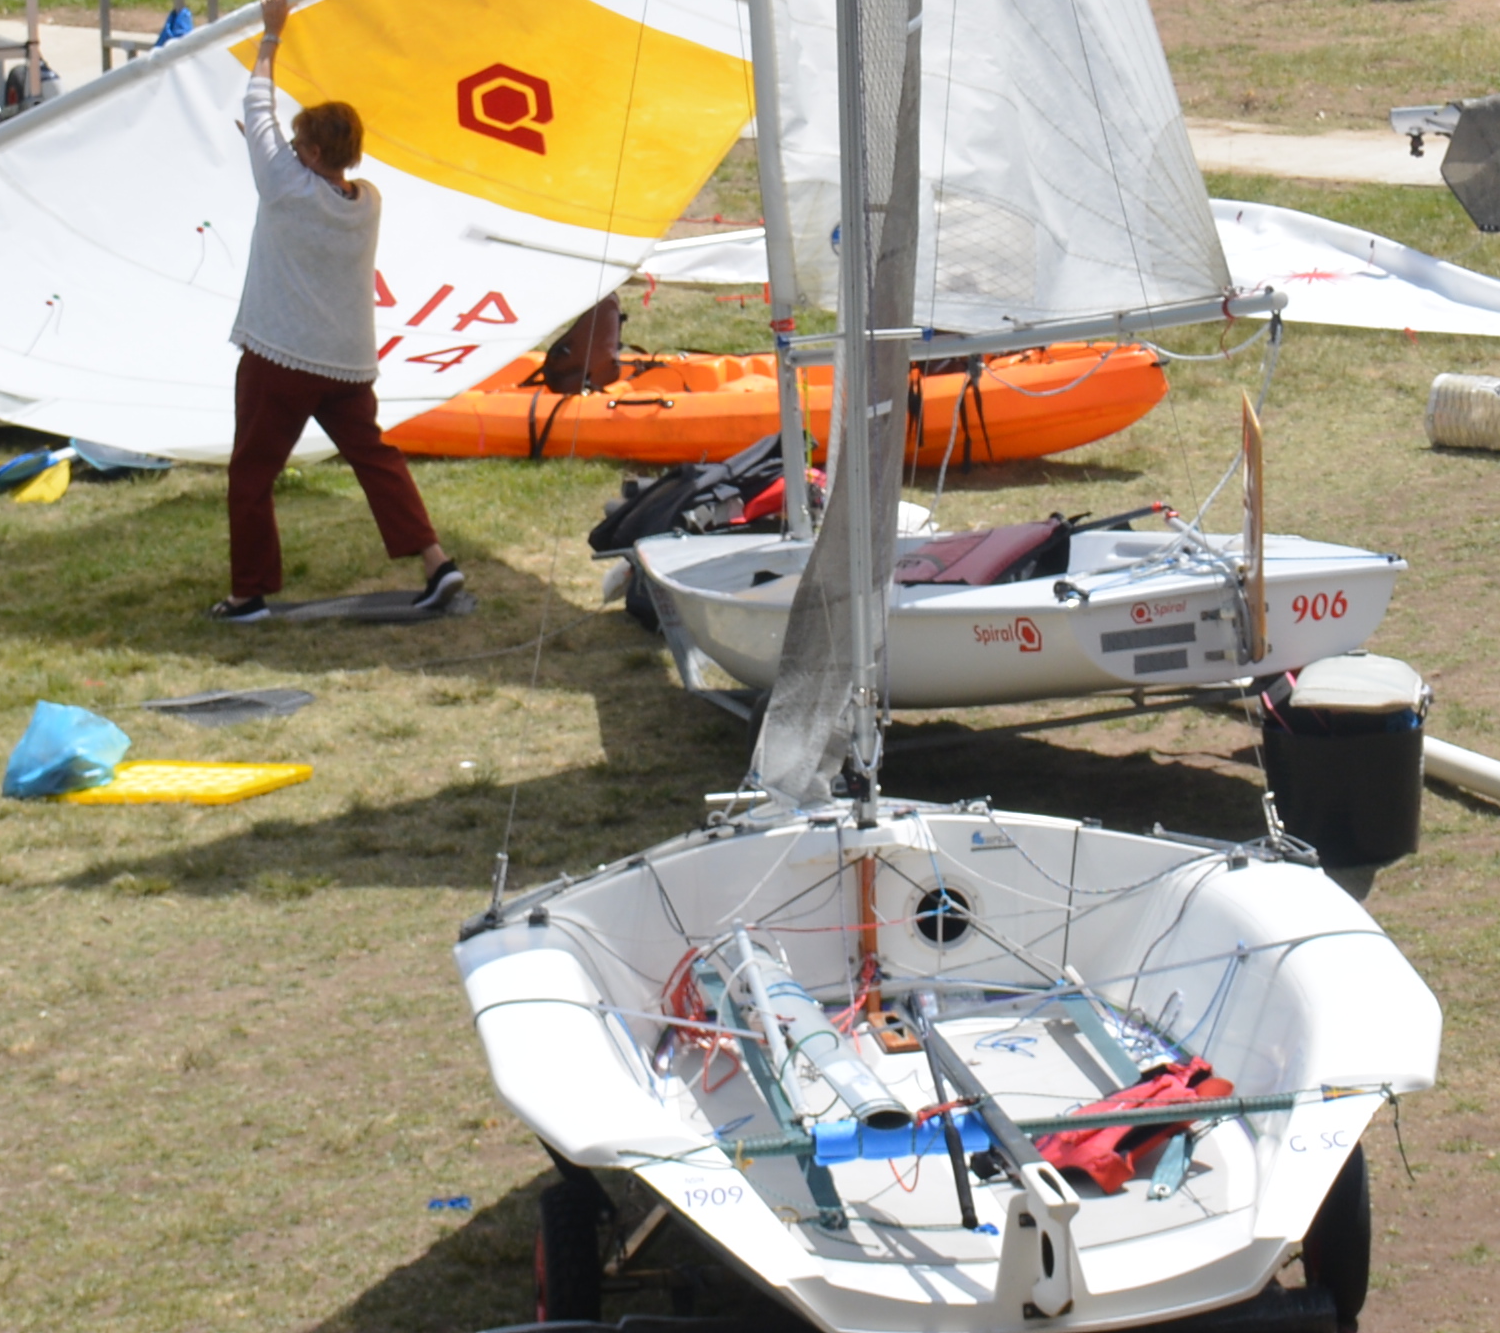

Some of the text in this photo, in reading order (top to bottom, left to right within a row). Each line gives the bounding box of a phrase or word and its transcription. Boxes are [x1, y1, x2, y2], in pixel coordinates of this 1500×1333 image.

[1153, 600, 1187, 616] Spiral
[1292, 589, 1349, 623] 906
[974, 622, 1013, 646] Spiral
[684, 1185, 744, 1208] 1909
